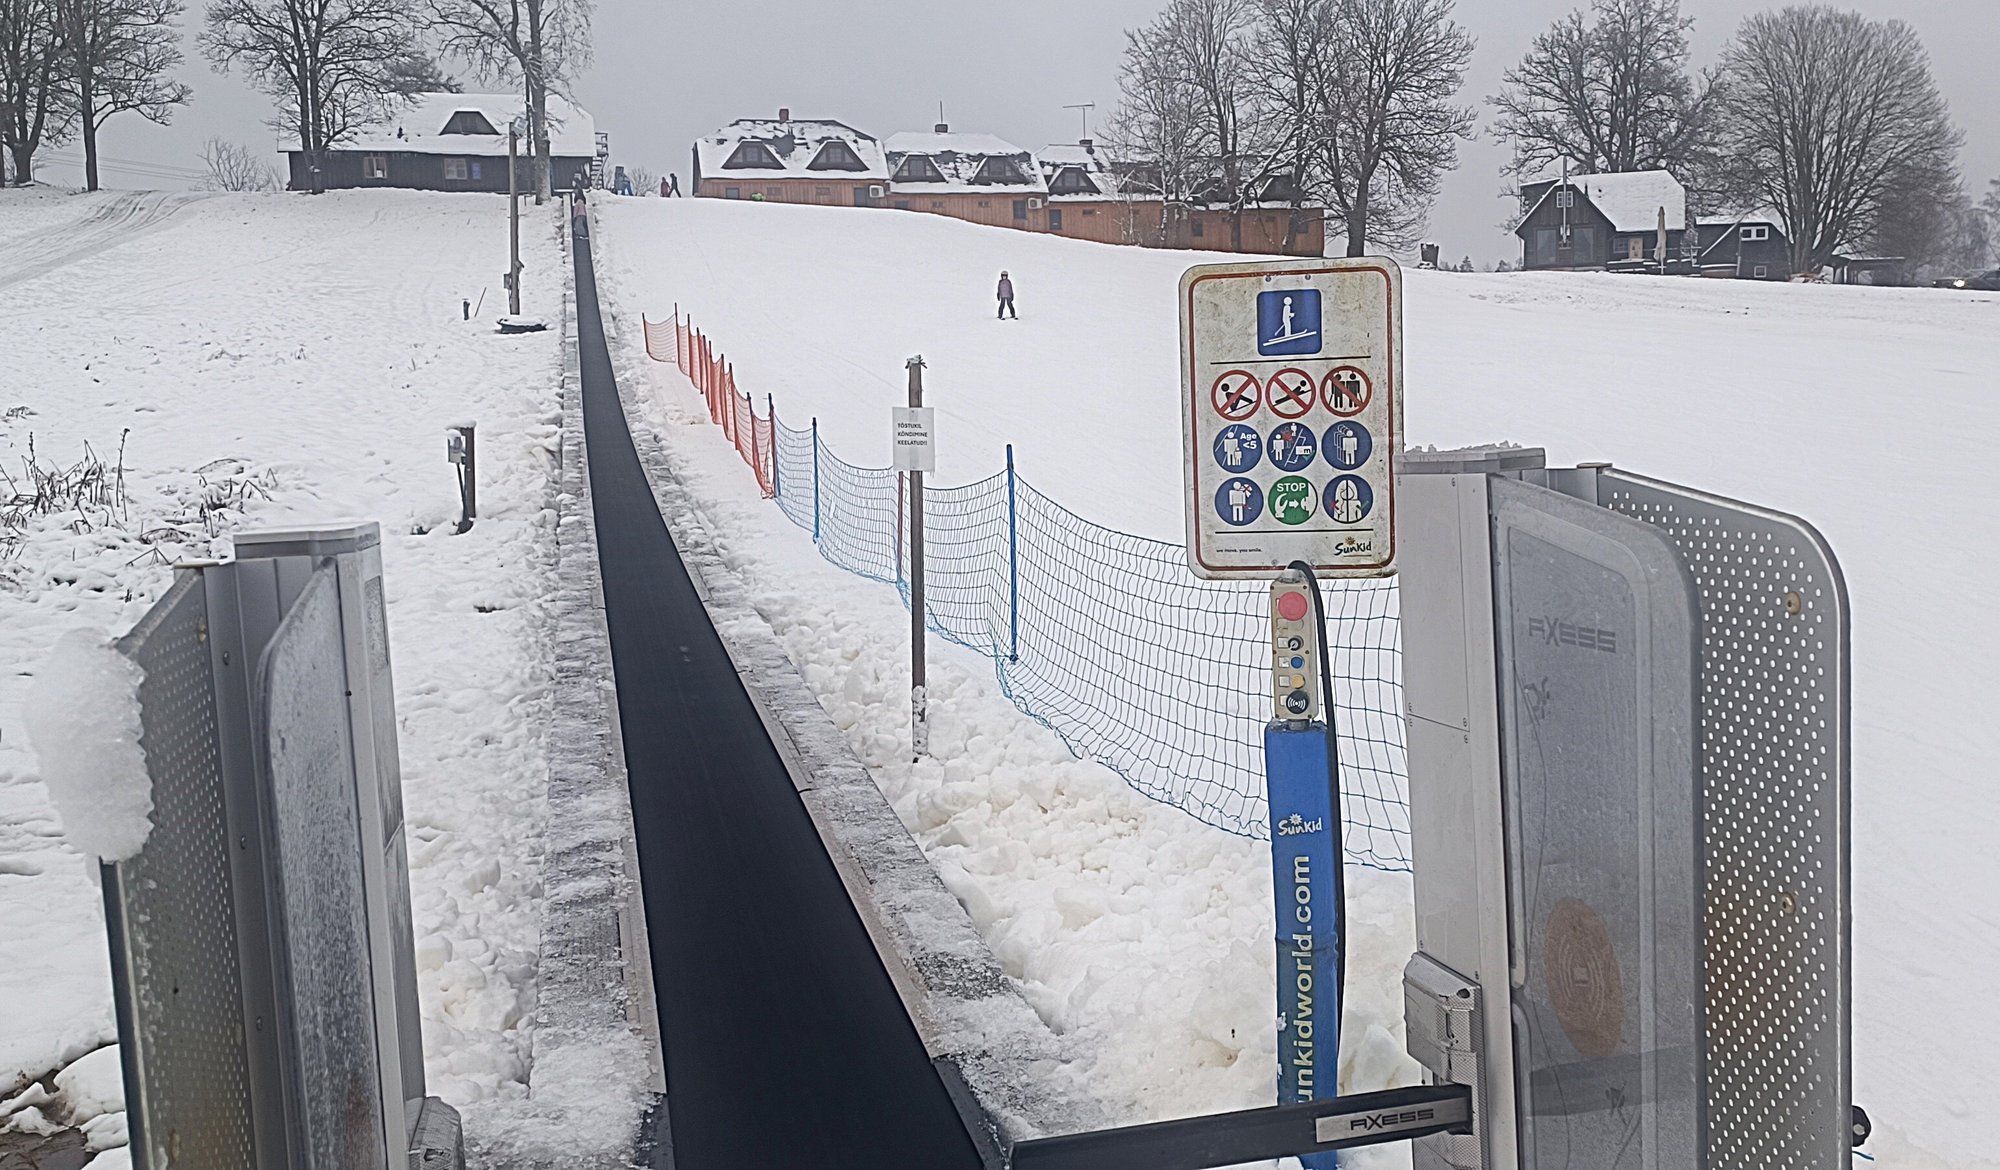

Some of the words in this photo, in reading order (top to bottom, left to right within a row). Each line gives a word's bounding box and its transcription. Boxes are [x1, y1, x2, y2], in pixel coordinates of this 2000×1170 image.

[1240, 432, 1257, 441] Age
[1276, 482, 1307, 493] STOP
[1528, 615, 1617, 654] AXESS
[1291, 855, 1314, 1104] unkidworld.com
[1349, 1108, 1434, 1131] AXESS
